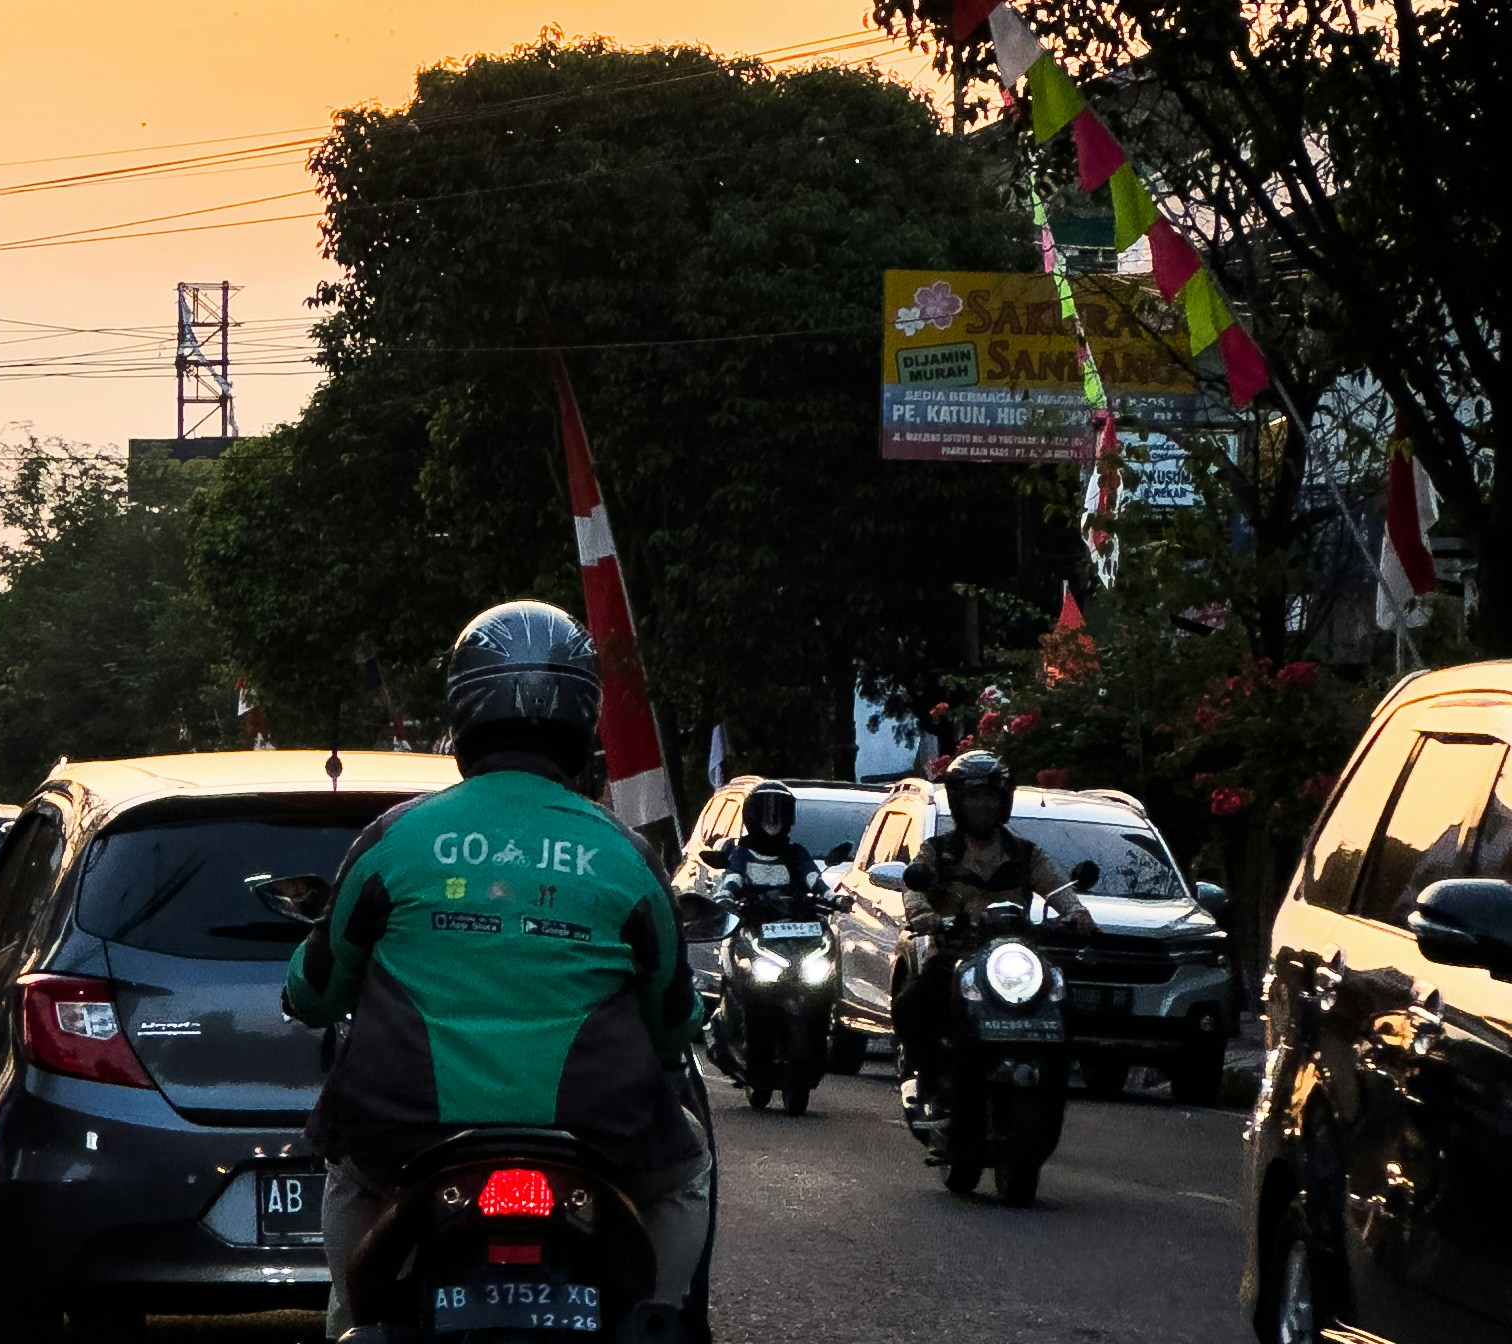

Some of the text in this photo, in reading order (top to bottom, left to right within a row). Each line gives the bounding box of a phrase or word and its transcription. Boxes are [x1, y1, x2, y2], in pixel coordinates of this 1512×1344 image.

[904, 350, 971, 368] DIJAMIN
[909, 365, 968, 382] MURAH
[892, 404, 920, 424] PE,
[926, 404, 991, 427] KATUN,
[434, 832, 599, 875] GO JEK
[268, 1179, 303, 1213] AB
[437, 1284, 597, 1308] AB 3752 XC
